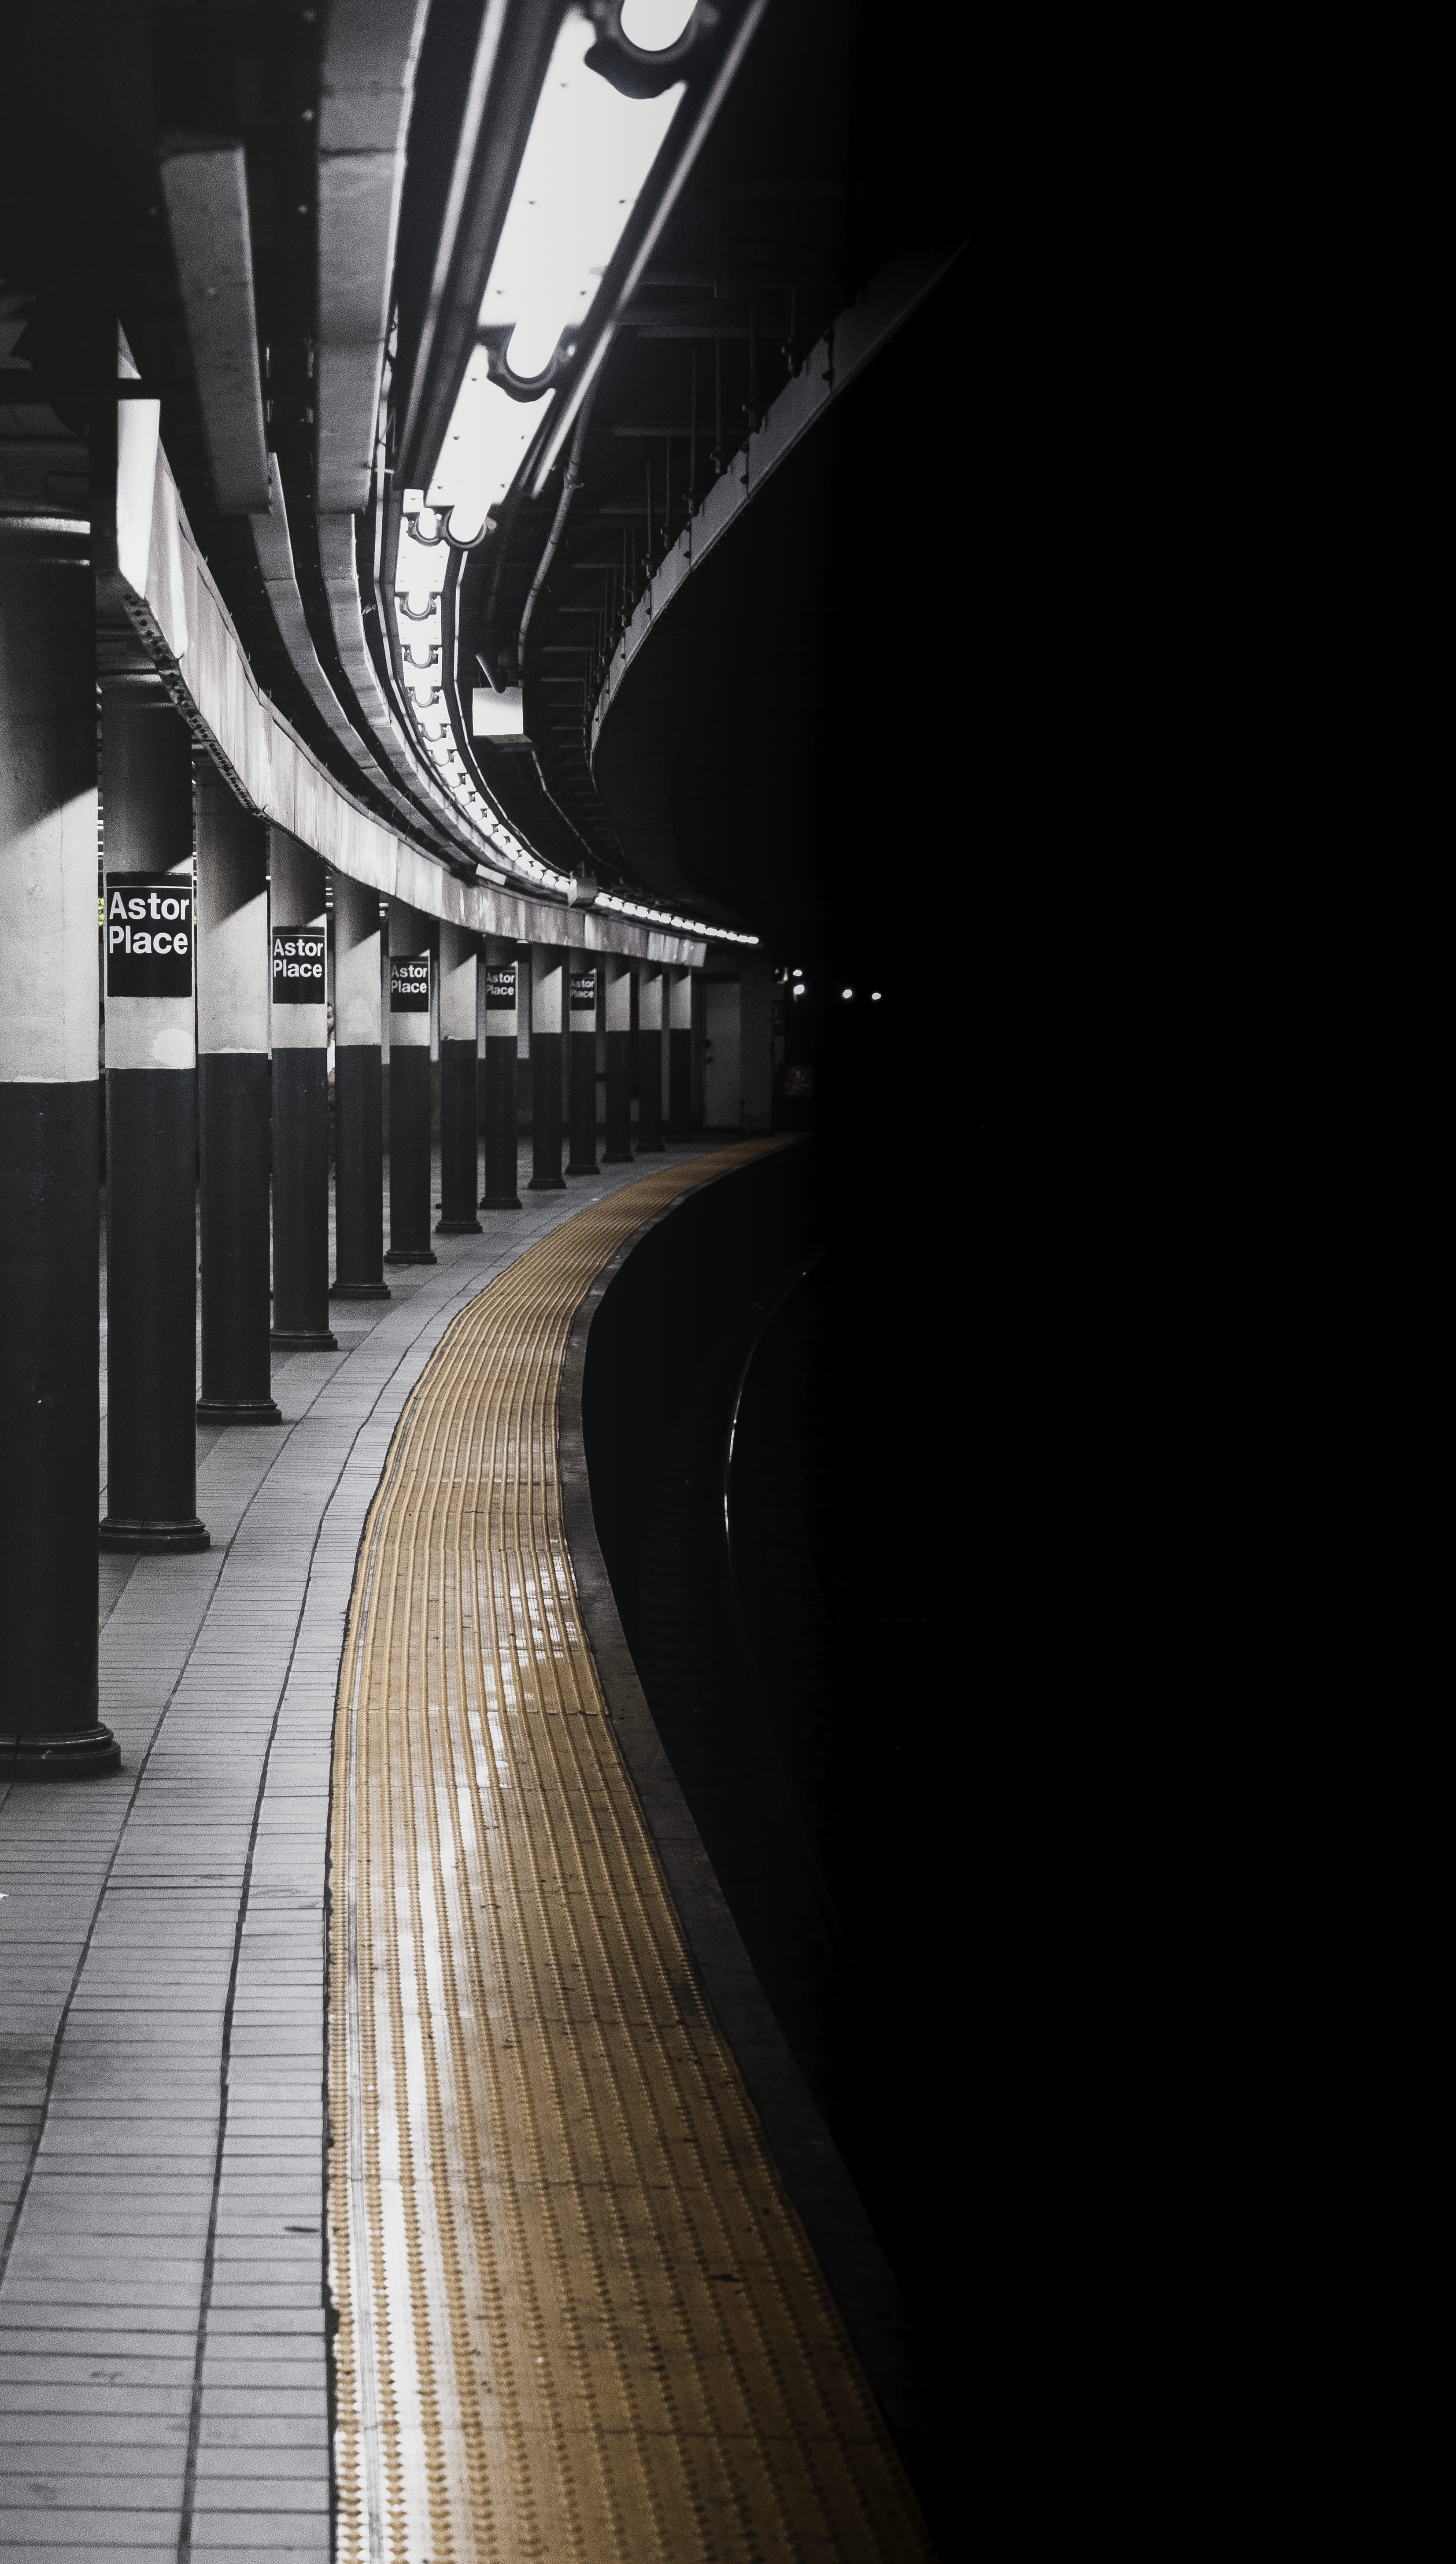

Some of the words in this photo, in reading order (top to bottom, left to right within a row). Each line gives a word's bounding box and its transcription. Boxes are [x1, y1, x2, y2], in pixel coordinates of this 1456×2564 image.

[109, 892, 189, 920] Astor
[109, 925, 188, 955] Place
[273, 939, 323, 956] Astor
[273, 959, 322, 977] Place
[391, 965, 428, 977] Astor
[391, 980, 427, 993] Place
